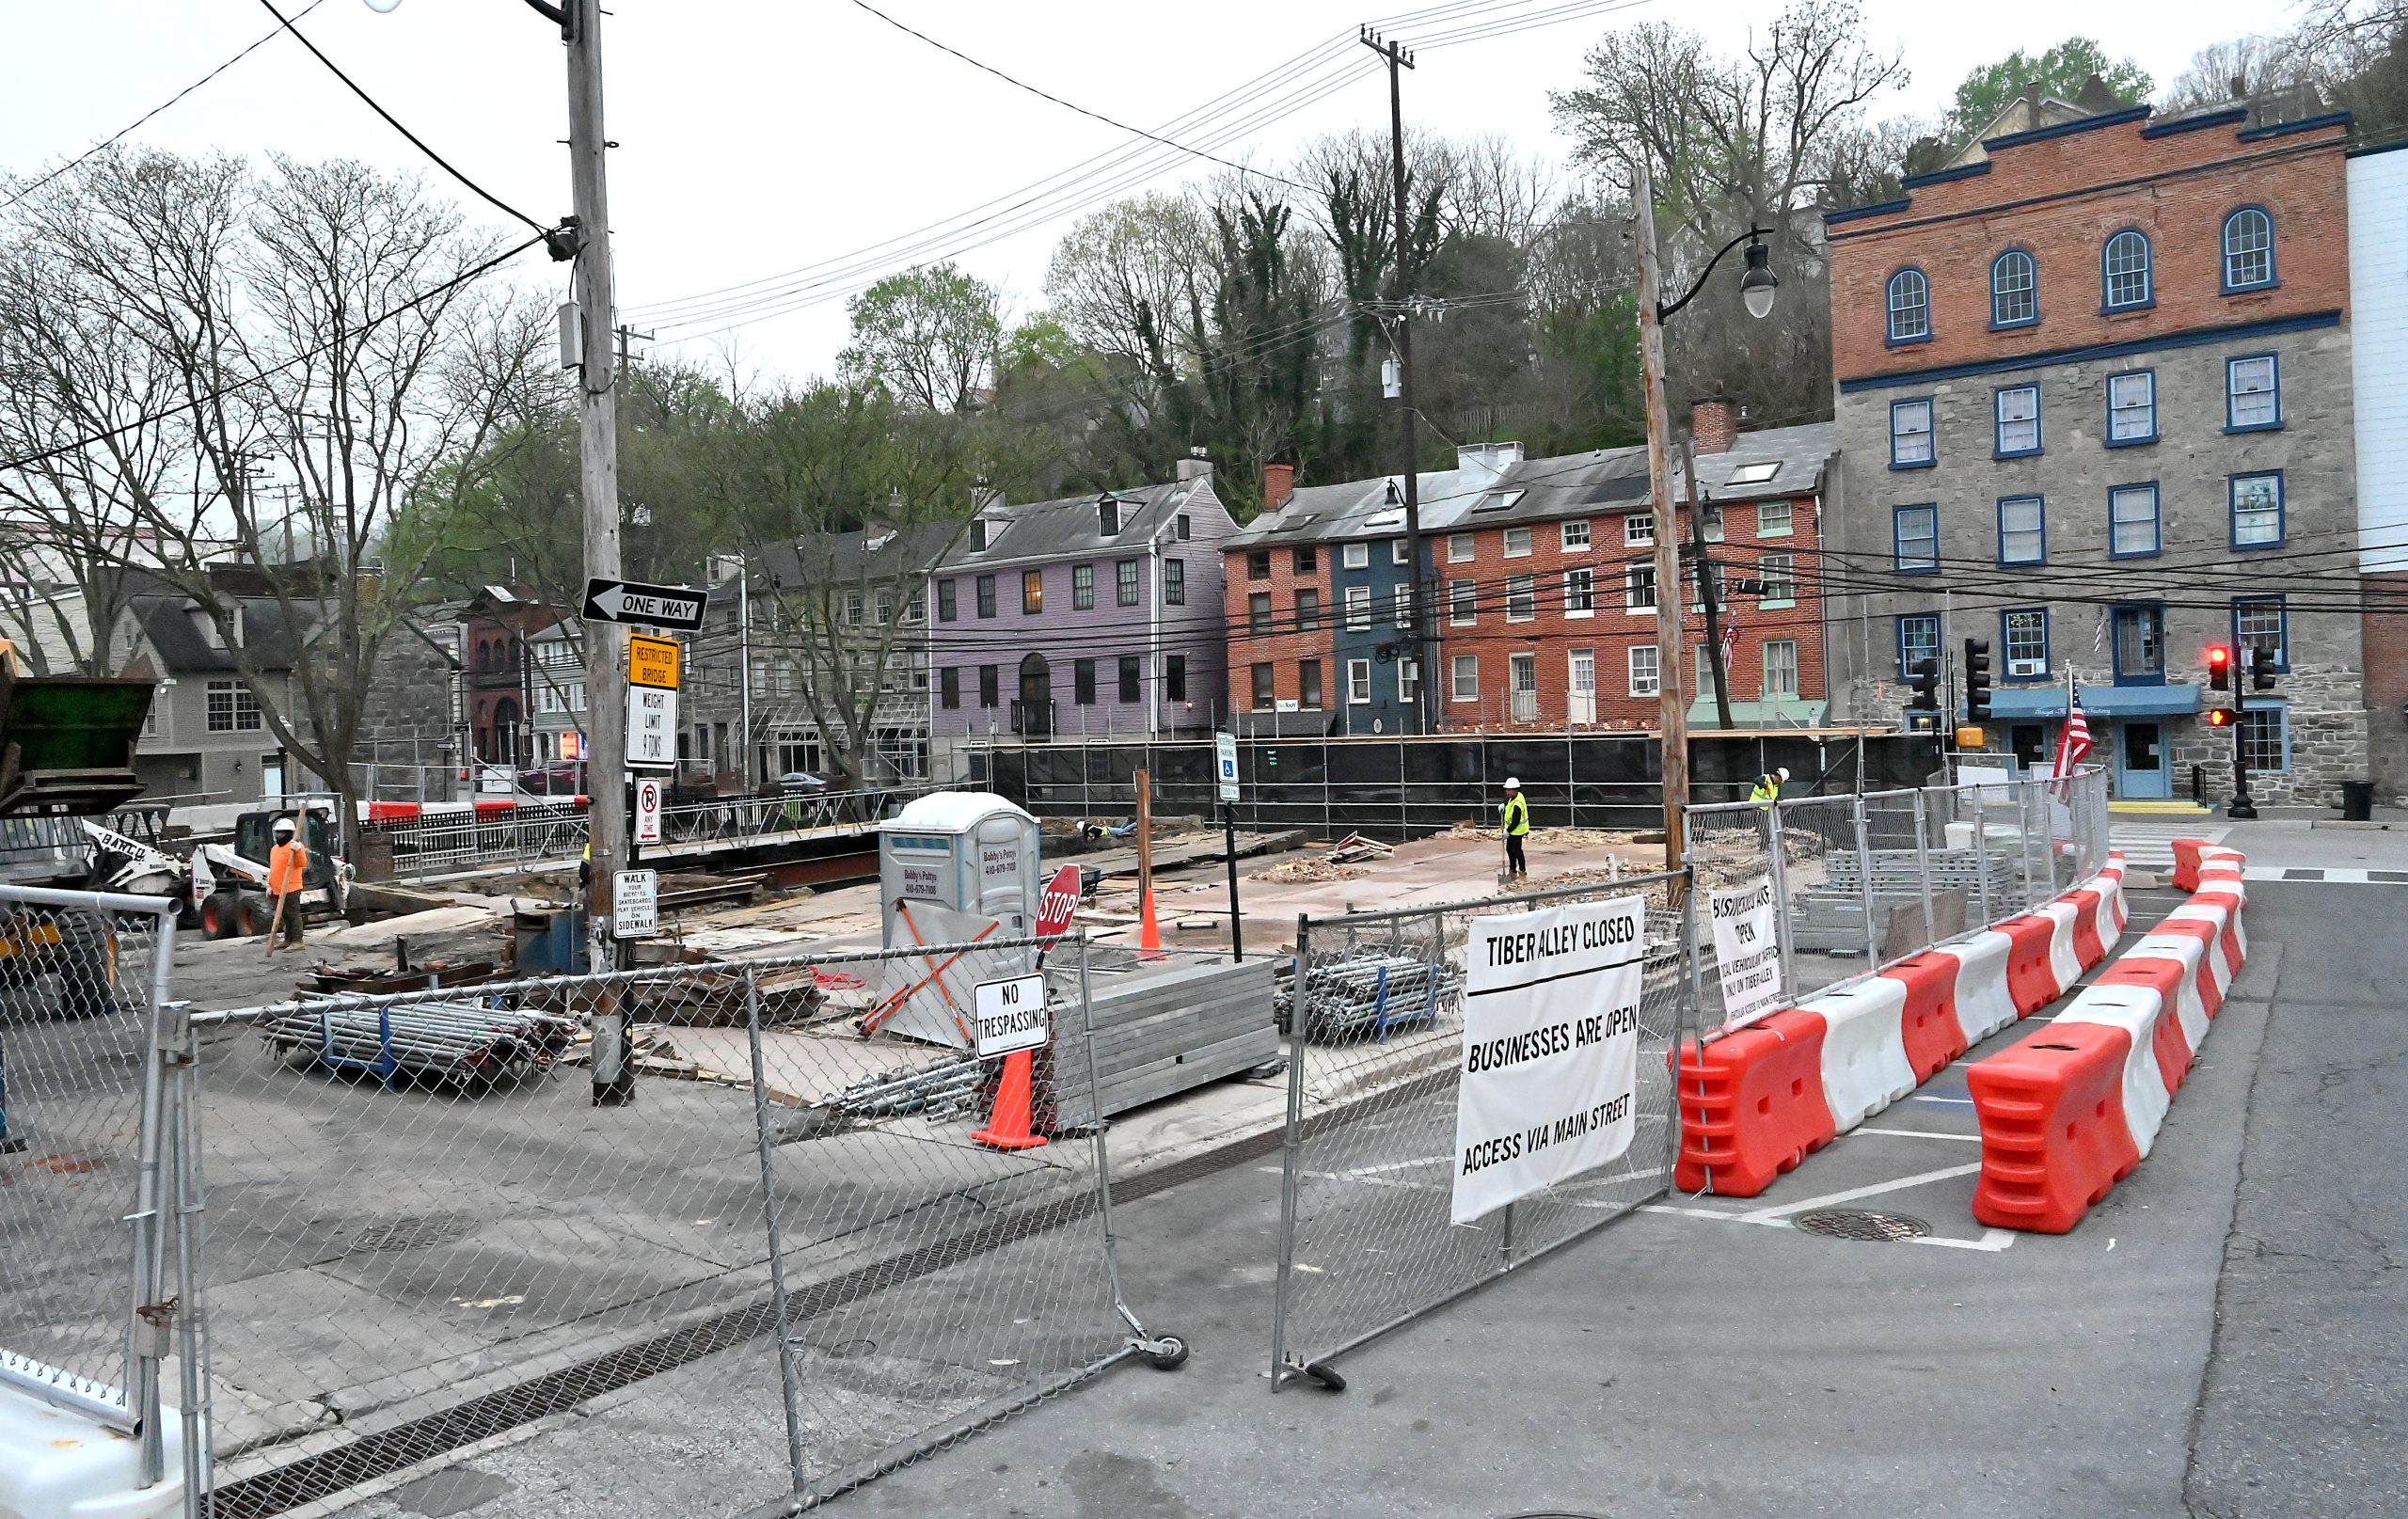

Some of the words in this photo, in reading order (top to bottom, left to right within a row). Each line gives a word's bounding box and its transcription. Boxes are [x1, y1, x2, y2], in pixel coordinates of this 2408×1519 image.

[623, 595, 656, 614] ONE
[661, 600, 694, 618] WAY
[636, 646, 673, 665] RESTRICTED
[642, 667, 667, 683] BRIDGE
[642, 692, 664, 709] WEIGHT
[645, 714, 660, 730] LIMIT
[643, 824, 654, 832] TIME
[644, 815, 653, 824] ANY
[983, 850, 1003, 862] Bobby's
[624, 874, 646, 883] WALK
[904, 869, 922, 882] Bobby's
[1038, 892, 1076, 925] STOP
[618, 919, 653, 930] SIDEWALK
[1735, 921, 1756, 945] OPEN
[1486, 932, 1536, 967] TIBER
[1537, 924, 1578, 959] ALLEY
[1583, 915, 1635, 950] CLOSED
[1002, 983, 1019, 1005] NO
[978, 1007, 1045, 1040] TRESPASSING
[1467, 1022, 1570, 1073] BUSINESSES
[1576, 1015, 1603, 1049] ARE
[1606, 1005, 1637, 1038] OPEN
[1462, 1132, 1522, 1176] ACCESS
[1527, 1124, 1549, 1154] VIA
[1553, 1111, 1588, 1145] MAIN
[1590, 1093, 1631, 1131] STREET
